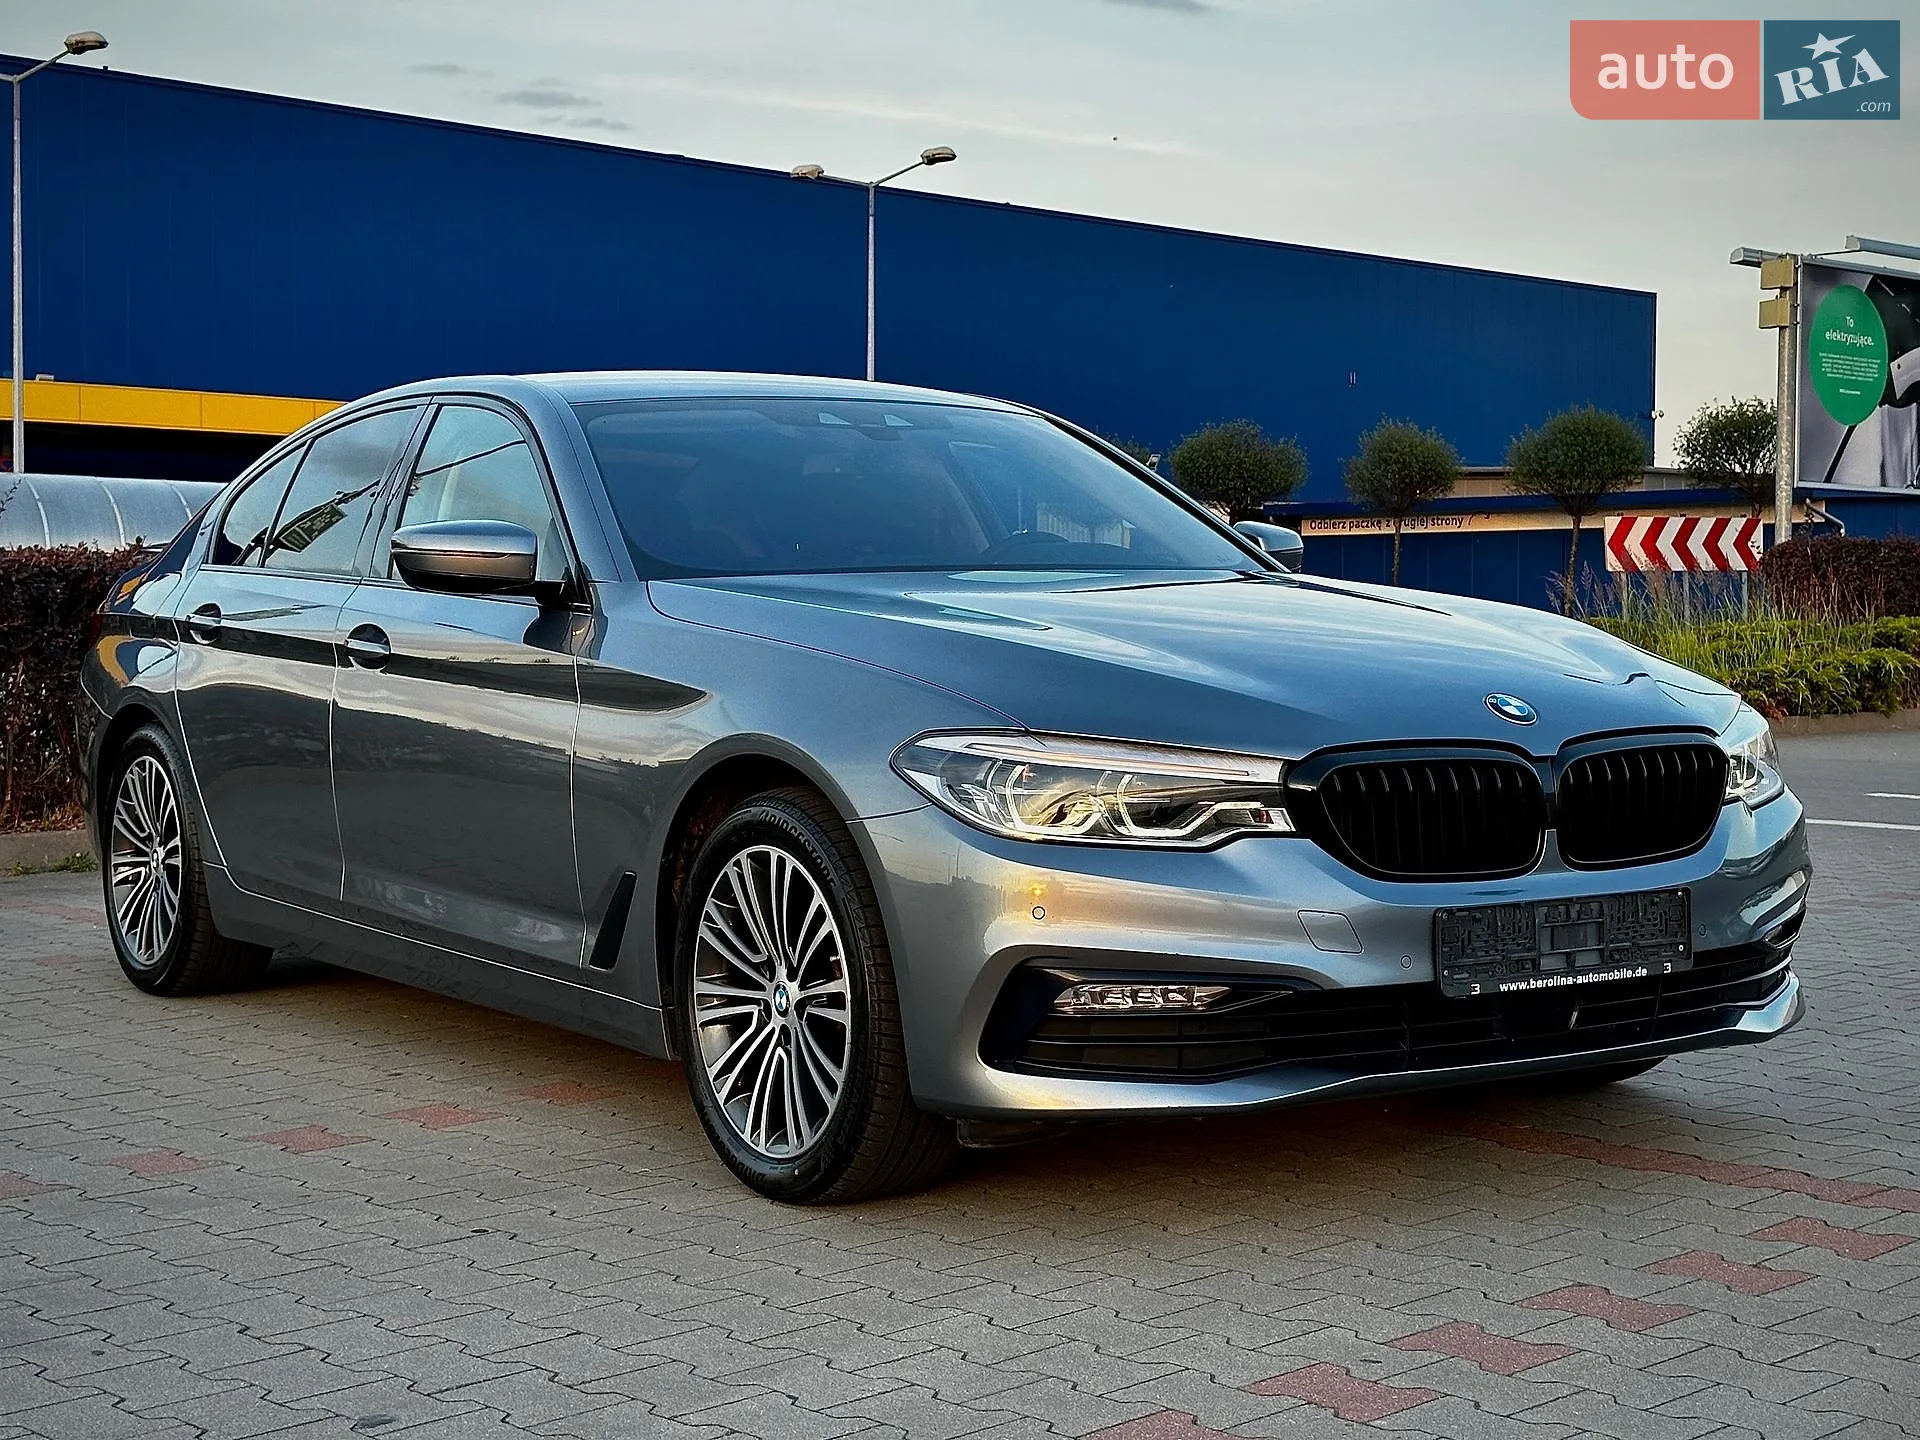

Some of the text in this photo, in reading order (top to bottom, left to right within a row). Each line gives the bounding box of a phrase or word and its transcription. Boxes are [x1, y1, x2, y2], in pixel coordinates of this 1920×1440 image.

[1846, 316, 1854, 328] To
[1825, 329, 1875, 347] elektryzujące.
[1310, 518, 1347, 530] Odbierz
[1348, 517, 1381, 531] paczkę
[1385, 519, 1391, 528] z
[1430, 515, 1463, 528] strony
[1499, 966, 1648, 992] www.berolina-automobile.de
